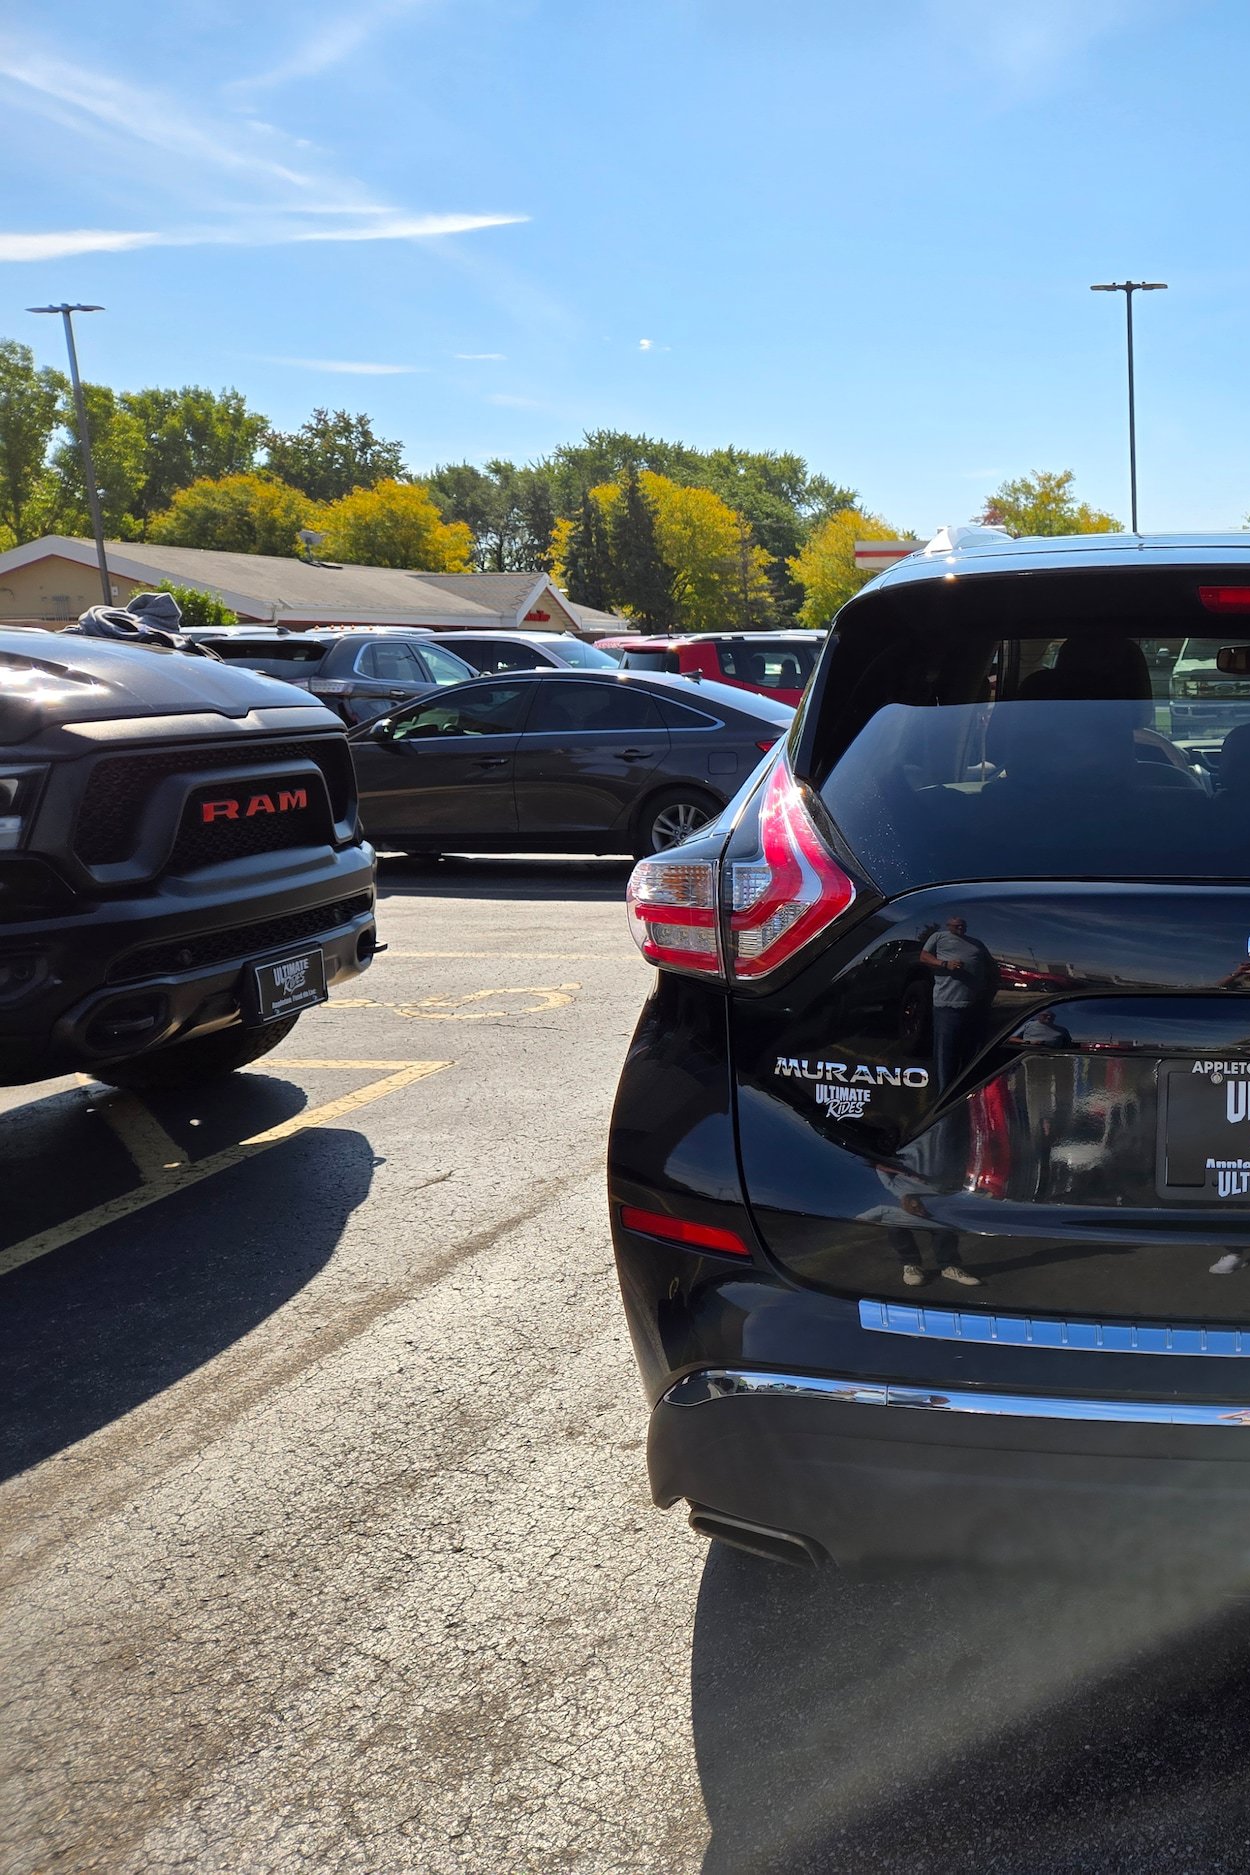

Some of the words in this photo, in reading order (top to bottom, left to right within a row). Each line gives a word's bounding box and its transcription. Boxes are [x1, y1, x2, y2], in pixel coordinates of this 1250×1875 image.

[202, 789, 308, 823] RAM
[273, 958, 309, 987] ULTIMATE
[774, 1056, 929, 1088] MURANO
[815, 1083, 871, 1104] ULTIMATE
